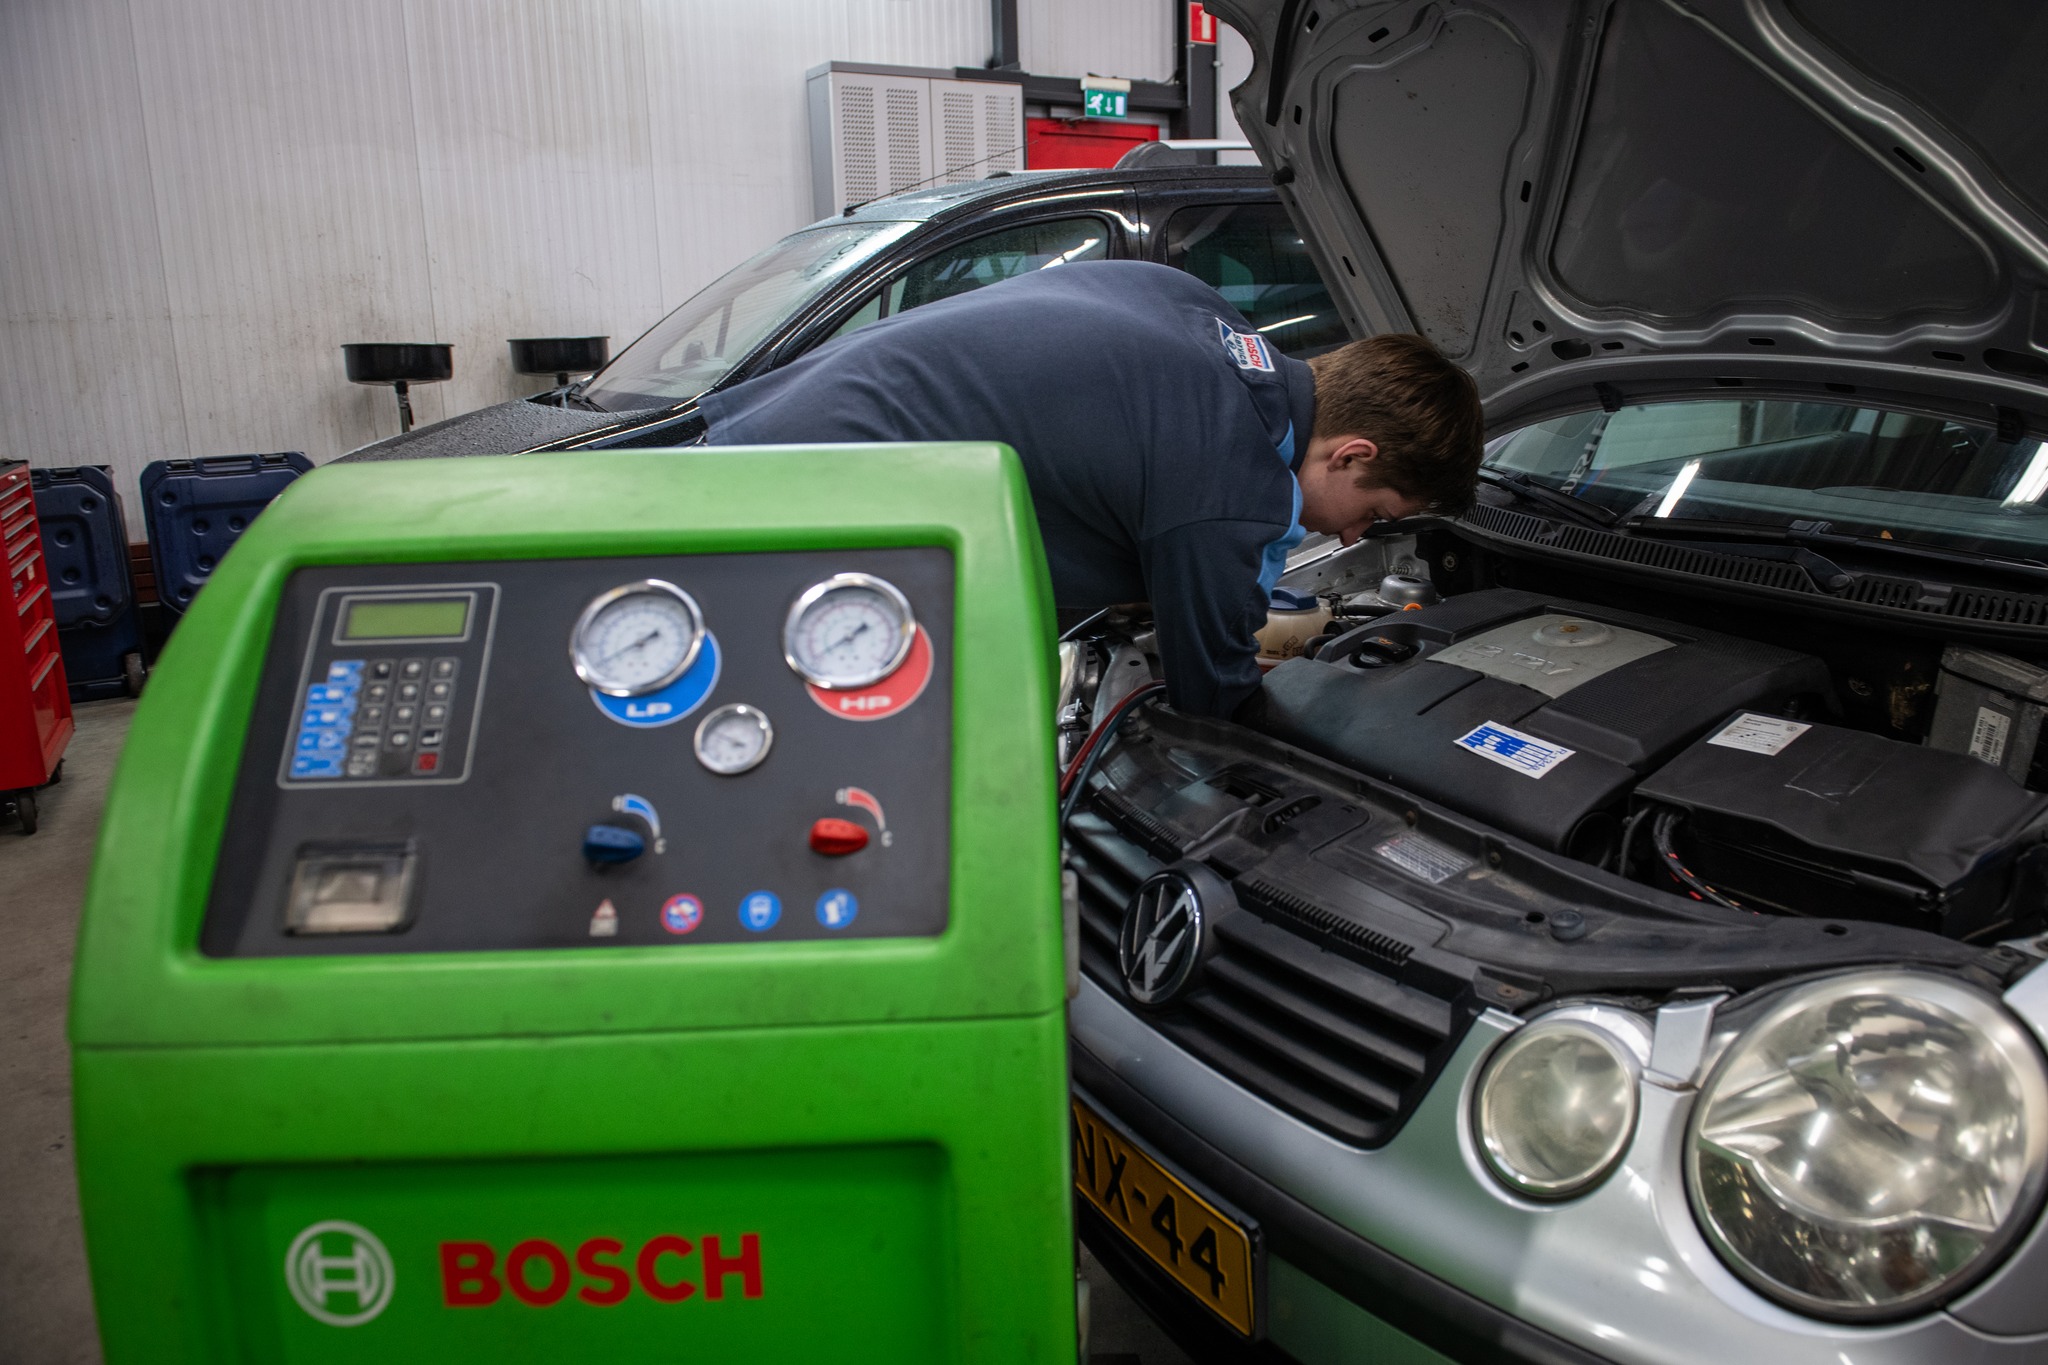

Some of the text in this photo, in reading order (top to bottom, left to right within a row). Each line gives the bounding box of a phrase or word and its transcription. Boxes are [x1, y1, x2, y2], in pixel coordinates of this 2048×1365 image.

[1232, 333, 1249, 366] Service
[1243, 337, 1263, 368] BOSCH
[626, 702, 672, 717] LP
[840, 695, 892, 711] HP
[438, 1233, 763, 1309] BOSCH
